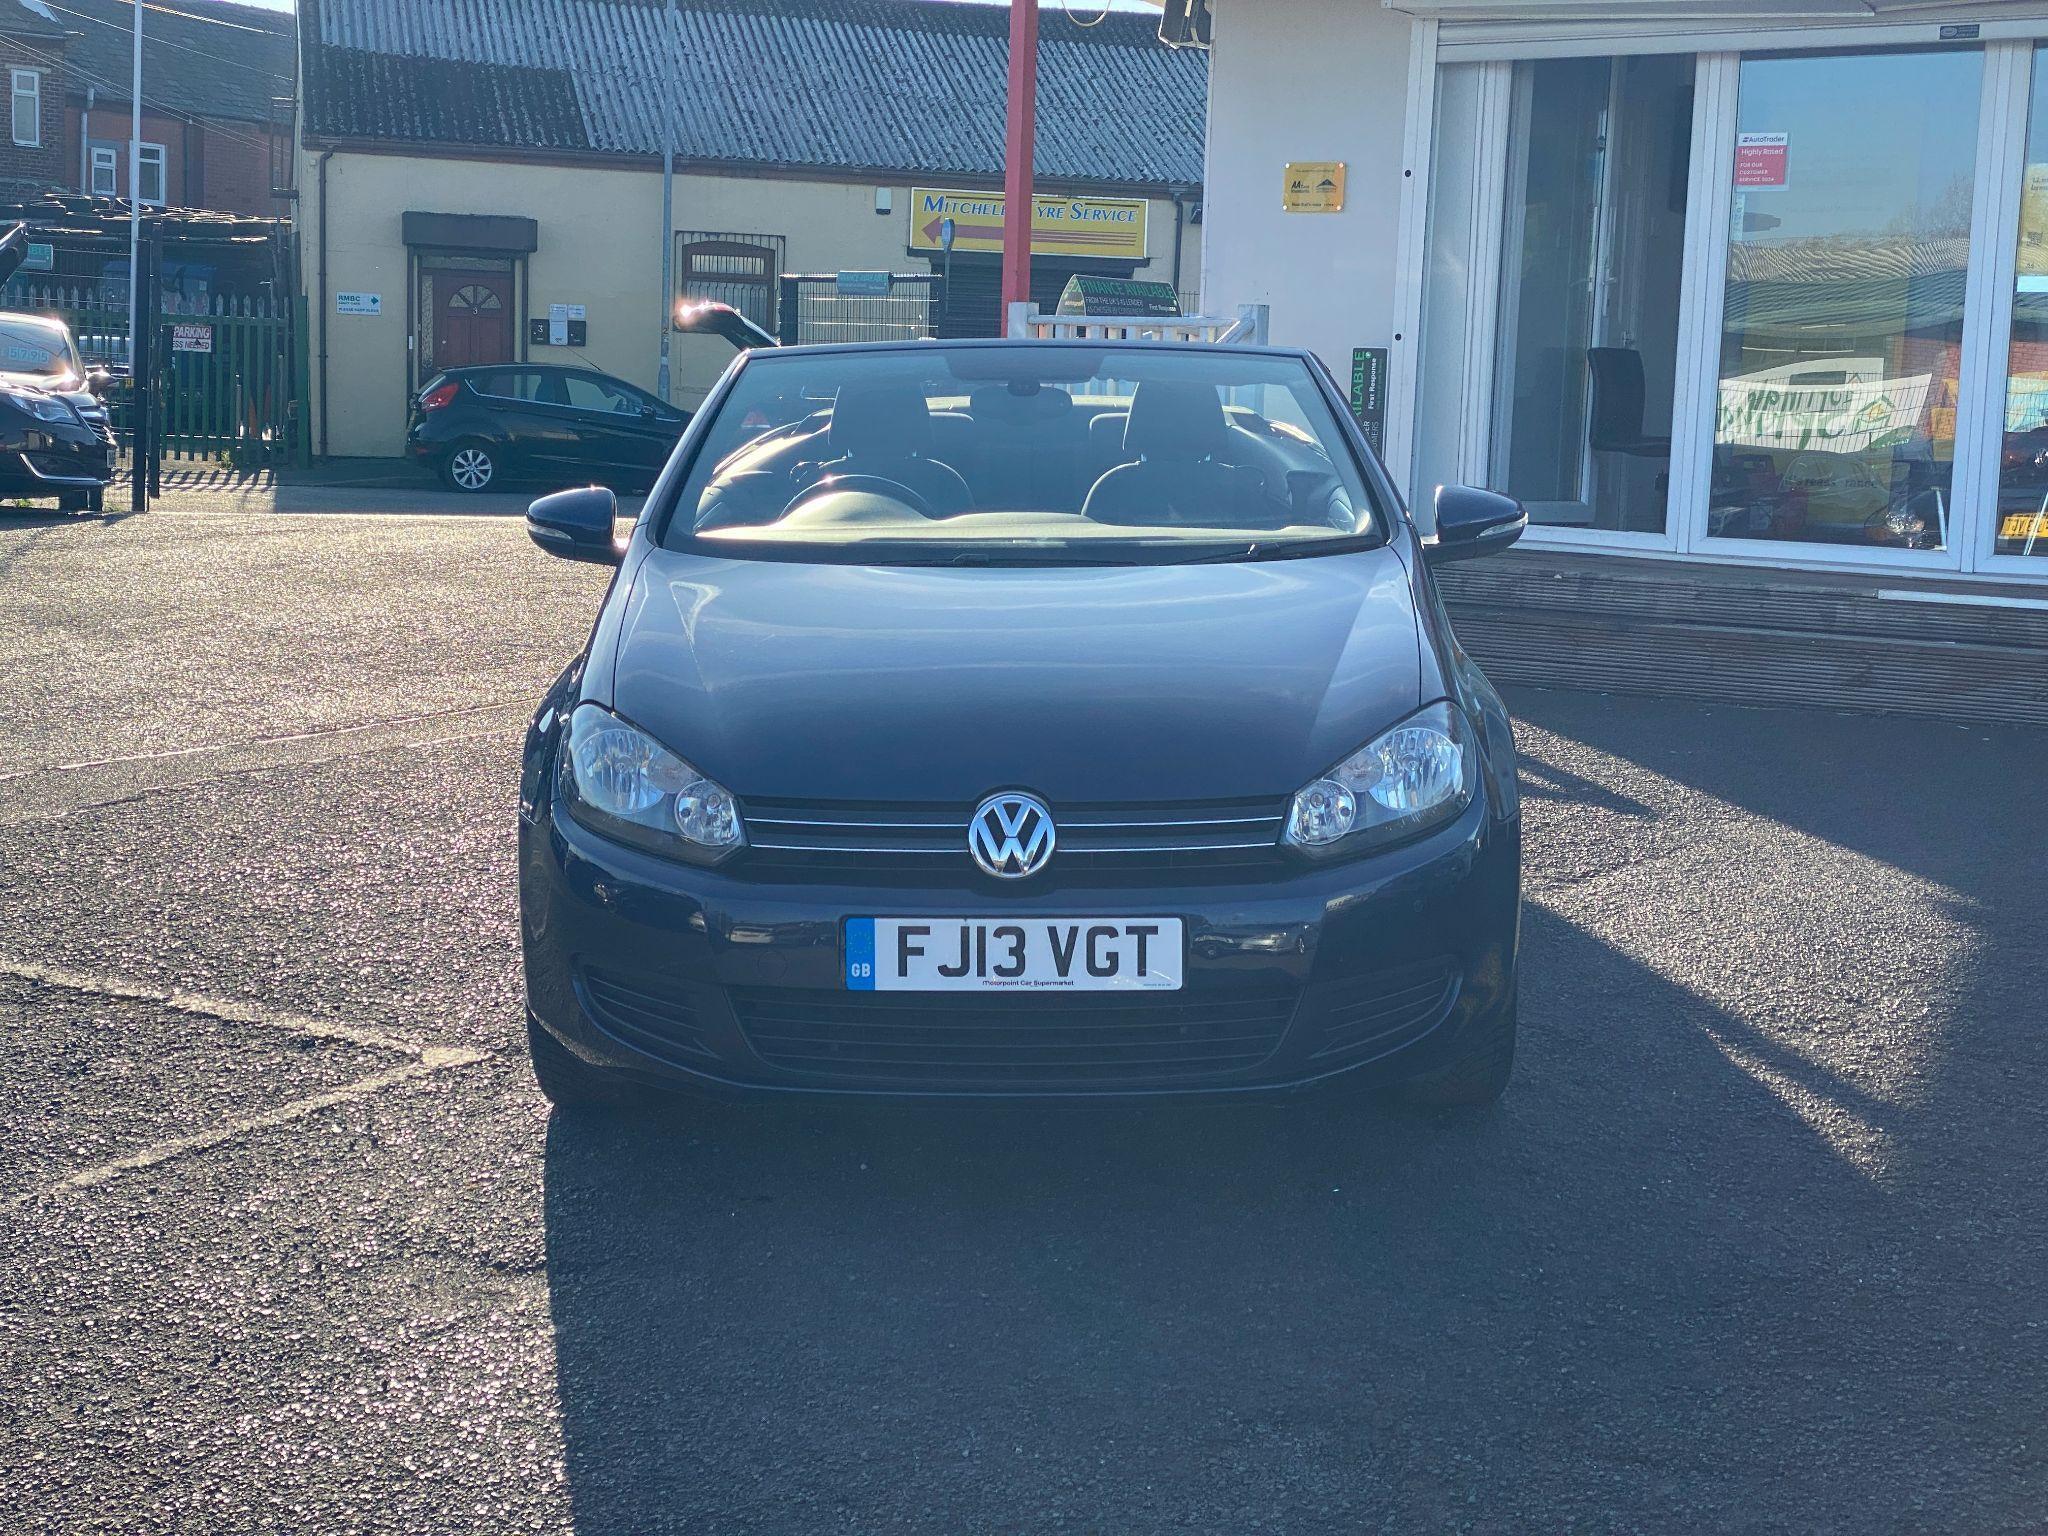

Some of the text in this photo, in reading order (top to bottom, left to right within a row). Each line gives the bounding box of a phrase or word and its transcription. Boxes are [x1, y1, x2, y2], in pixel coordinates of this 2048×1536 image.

[1741, 148, 1763, 157] Highly
[1070, 202, 1138, 222] SERVICE
[1080, 279, 1125, 295] FINANCE
[1125, 282, 1175, 299] AVAILABLE
[173, 326, 210, 339] PARKING
[1369, 358, 1377, 392] Response
[897, 925, 1159, 978] FJ13 VGT
[851, 963, 871, 977] GB
